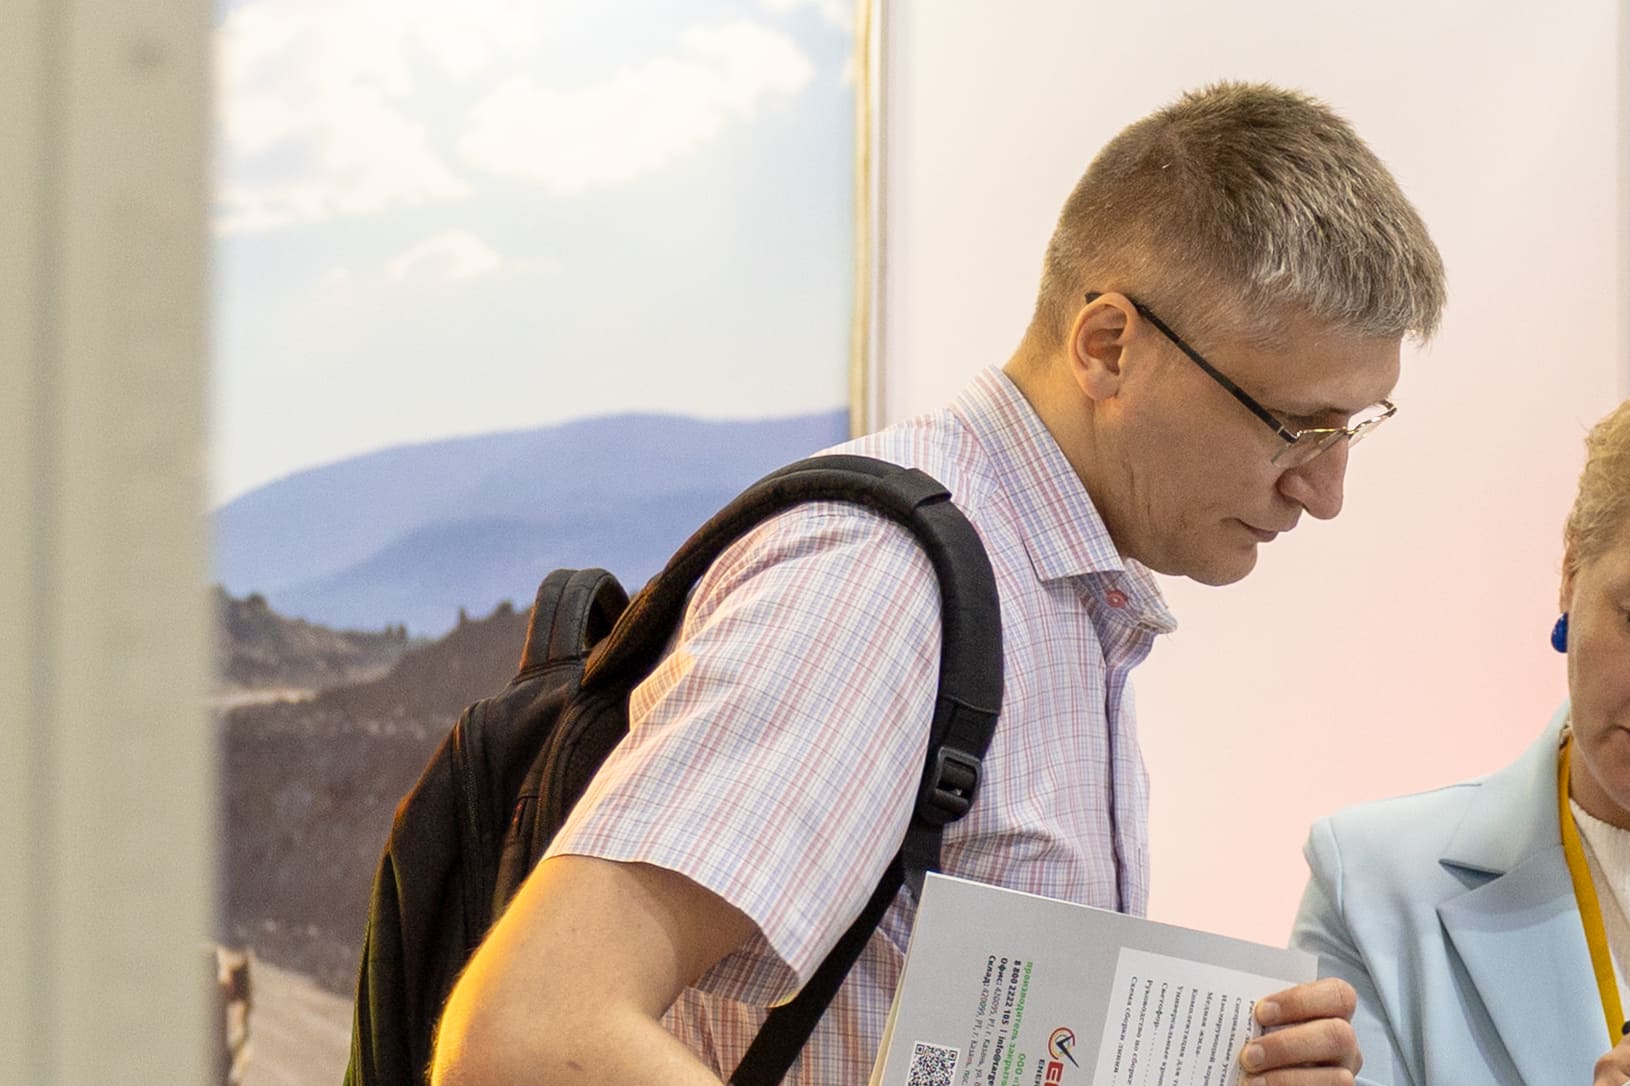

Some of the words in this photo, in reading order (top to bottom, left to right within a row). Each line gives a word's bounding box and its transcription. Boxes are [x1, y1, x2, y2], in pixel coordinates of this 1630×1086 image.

[982, 954, 996, 986] Склад:
[995, 957, 1008, 985] Офис:
[1009, 966, 1020, 984] 800
[1004, 984, 1016, 1007] 2222
[1010, 961, 1033, 1040] производитель
[1126, 976, 1138, 1006] Схема
[1001, 1009, 1011, 1025] 105
[1014, 1052, 1026, 1075] ООО
